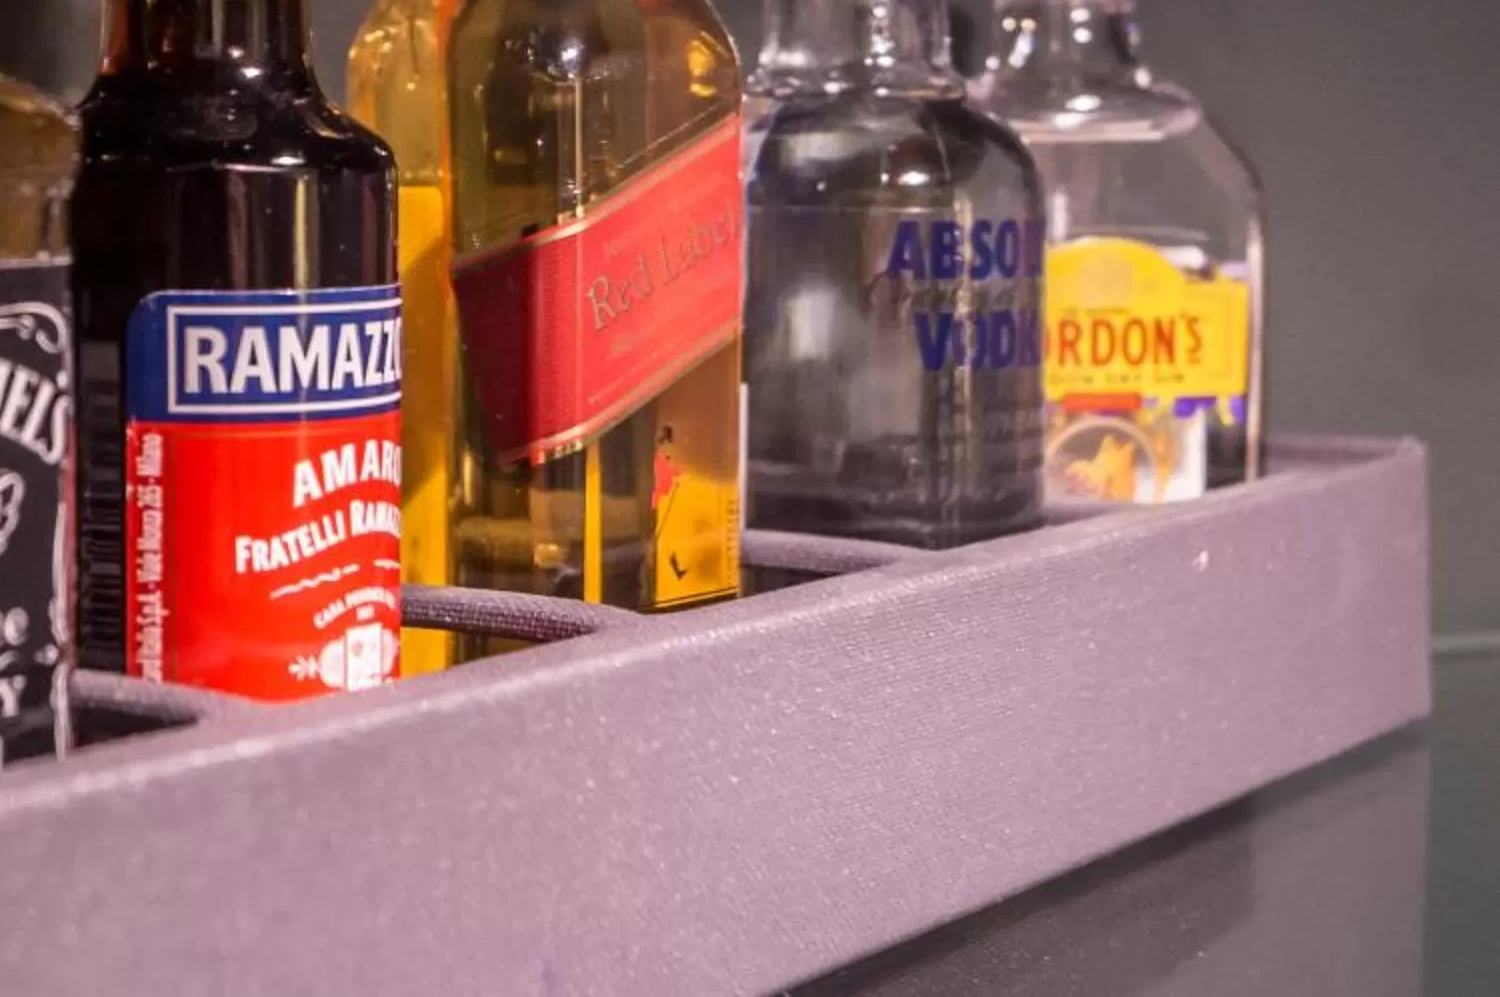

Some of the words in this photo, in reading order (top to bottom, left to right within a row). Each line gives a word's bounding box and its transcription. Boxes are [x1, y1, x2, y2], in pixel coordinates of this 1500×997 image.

[587, 250, 654, 331] Red
[1041, 310, 1203, 367] RDON'S
[235, 509, 347, 574] FRATELLI
